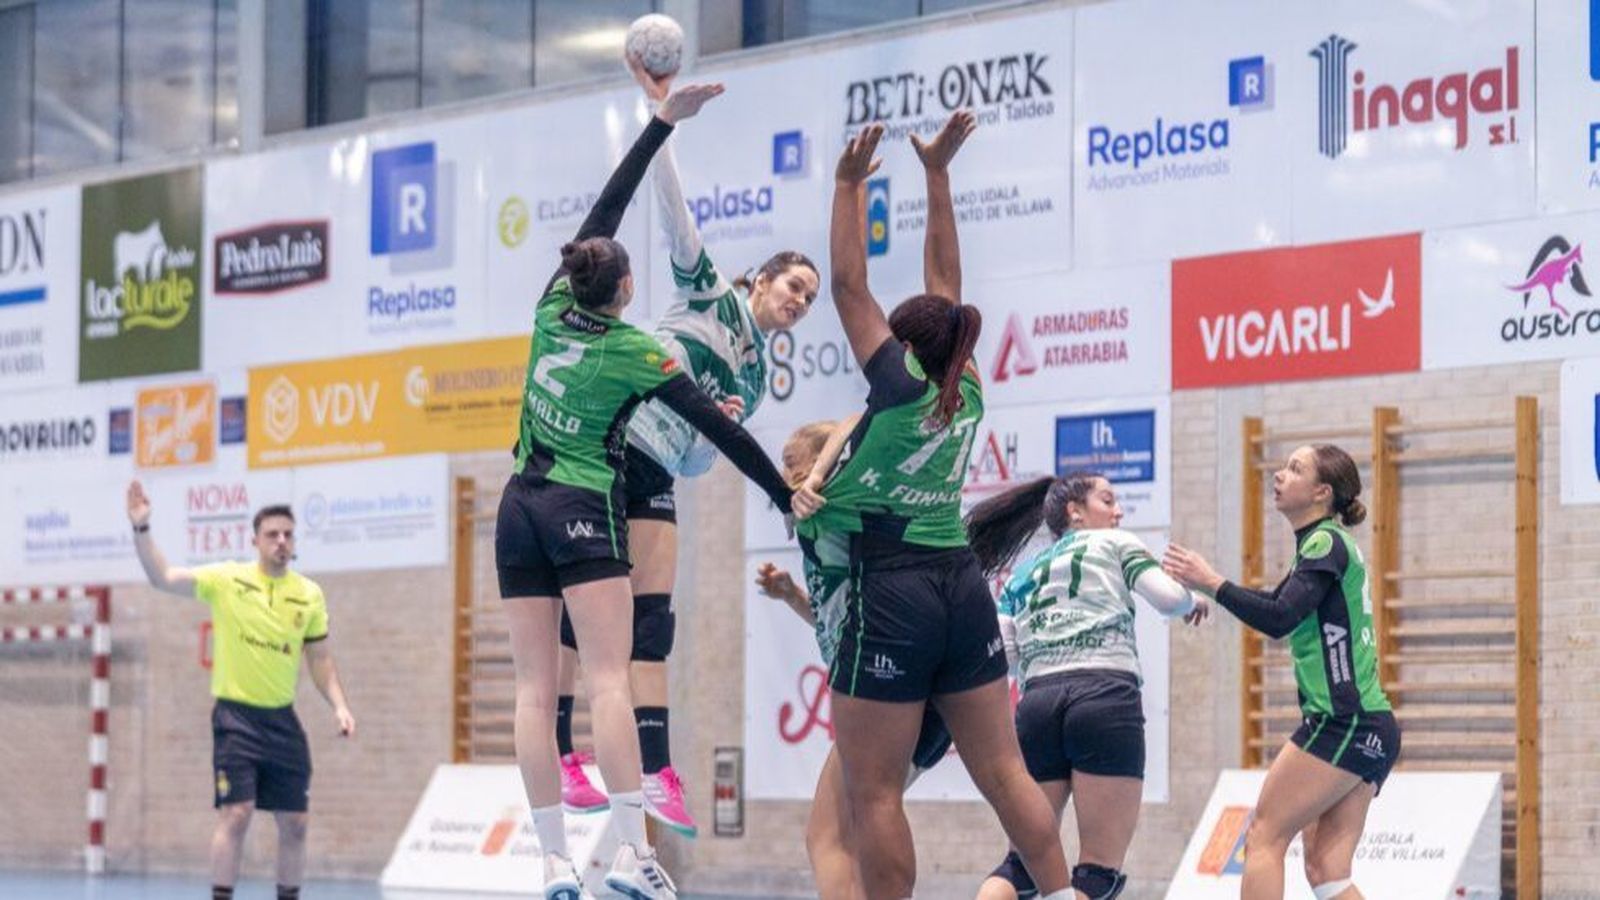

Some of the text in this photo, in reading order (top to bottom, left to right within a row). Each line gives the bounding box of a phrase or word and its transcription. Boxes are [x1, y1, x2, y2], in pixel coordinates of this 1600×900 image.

[1244, 74, 1260, 97] R
[1353, 46, 1519, 150] inagal
[1006, 101, 1055, 121] Taldea
[1088, 117, 1229, 168] Replasa
[1162, 158, 1231, 183] Materials
[400, 183, 426, 235] R
[686, 185, 773, 230] plasa
[980, 185, 1019, 204] UDALA
[987, 206, 1001, 220] DE
[1005, 197, 1054, 217] VILLAVA
[368, 284, 456, 317] Replasa
[1033, 307, 1129, 337] ARMADURAS
[1198, 303, 1351, 361] VICARLI
[533, 337, 587, 399] 2
[802, 341, 854, 378] SOL
[1044, 341, 1129, 368] ATARRABIA
[308, 380, 380, 426] VDV
[527, 391, 582, 434] MALLO
[188, 483, 249, 512] NOVA
[188, 524, 250, 552] TEXT
[1030, 544, 1088, 613] 27
